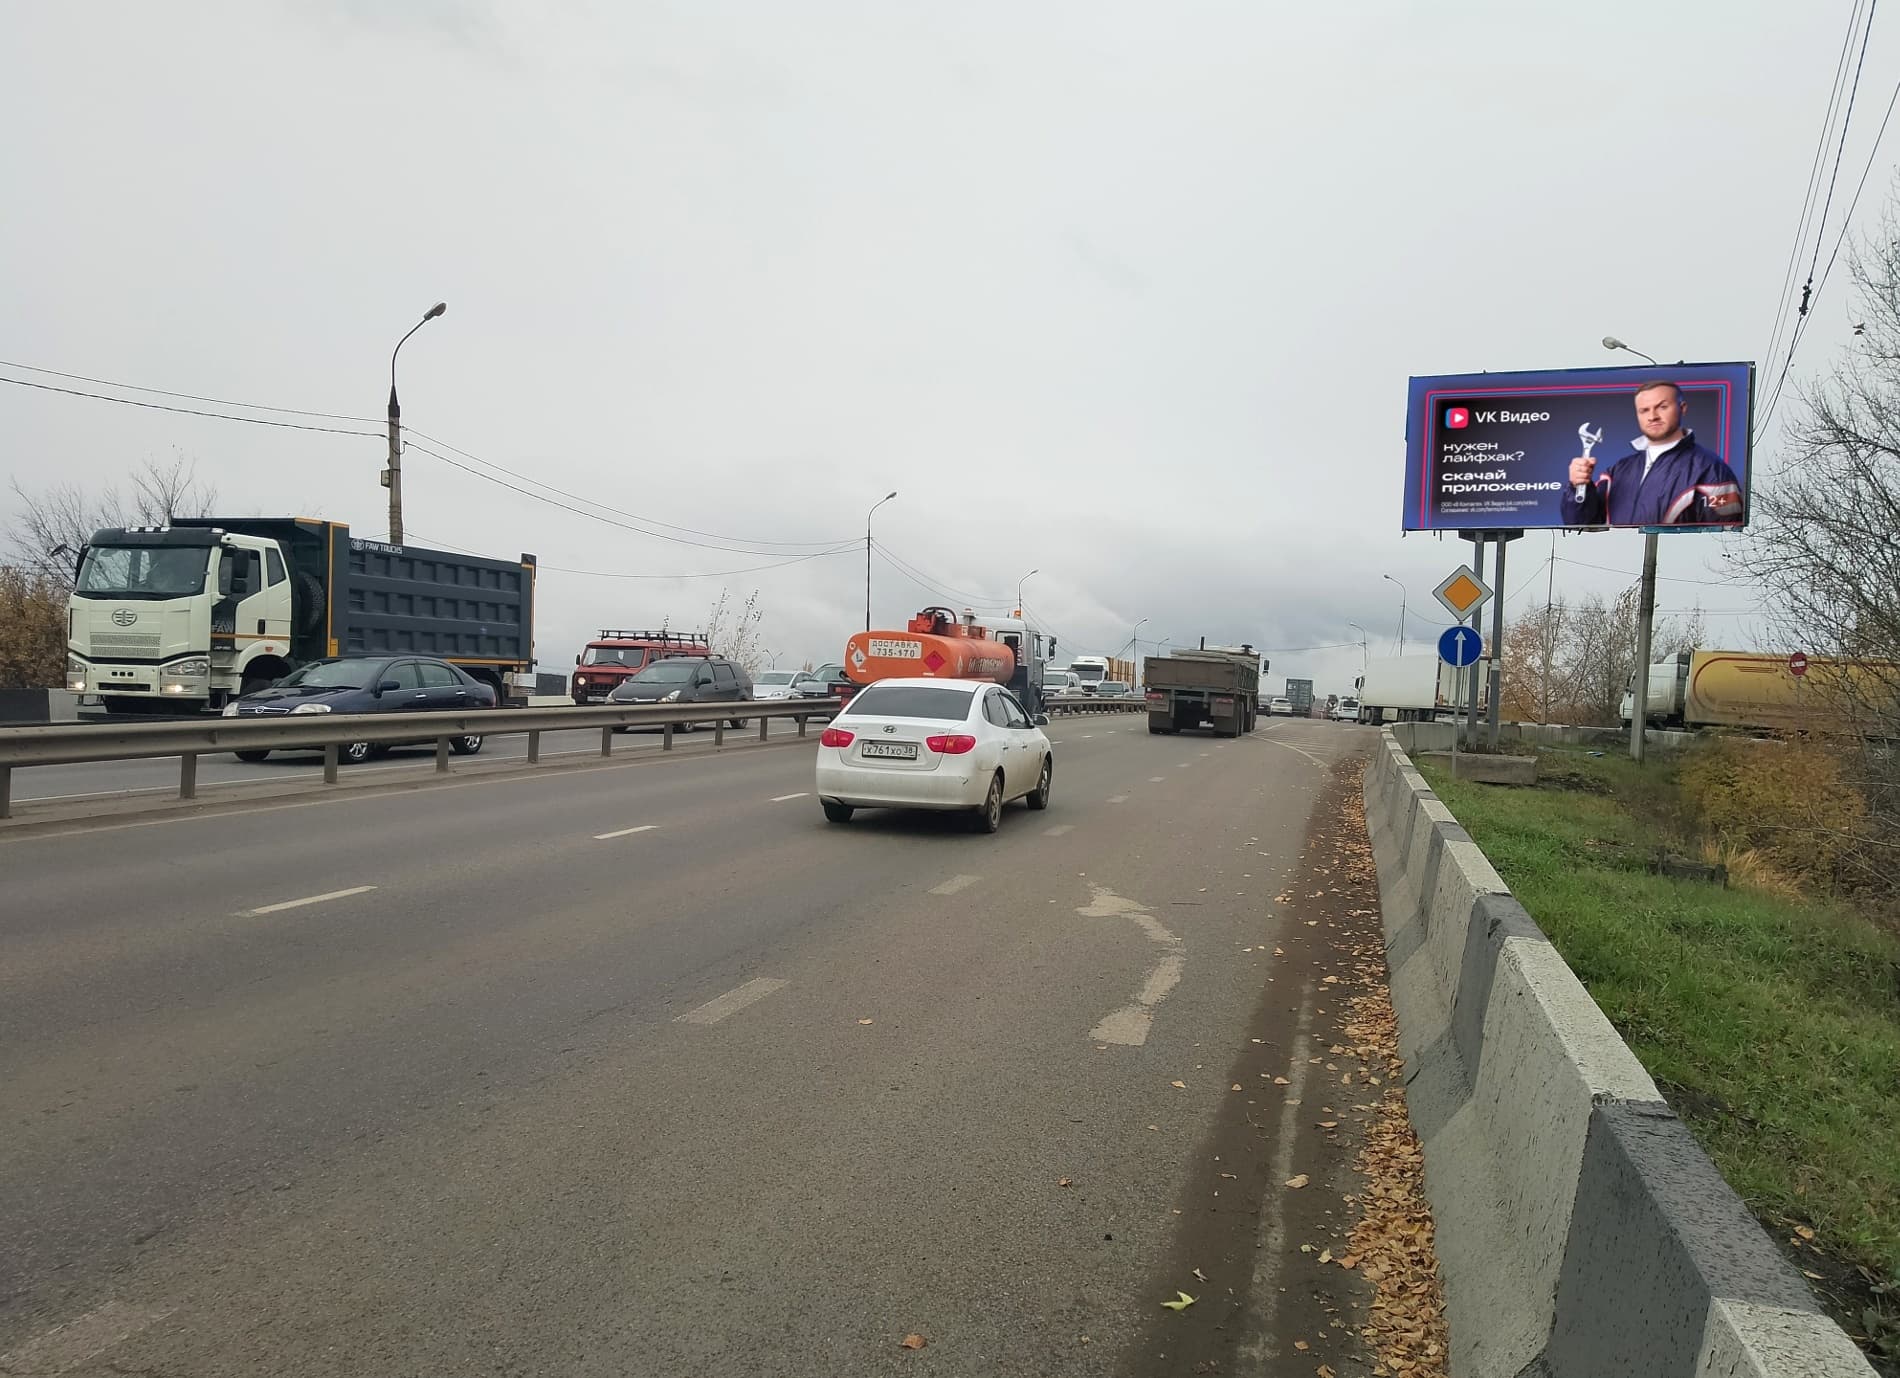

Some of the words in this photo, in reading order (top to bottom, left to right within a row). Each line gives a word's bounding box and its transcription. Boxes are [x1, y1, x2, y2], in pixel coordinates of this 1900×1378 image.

[1475, 411, 1497, 423] VK
[1500, 411, 1551, 424] Видео
[1443, 442, 1499, 454] нужен
[1442, 451, 1525, 464] лайфхак?
[1441, 469, 1507, 481] скачай
[1441, 482, 1562, 494] приложение
[1701, 496, 1727, 508] 12+
[872, 640, 919, 649] ДОСТАВКА
